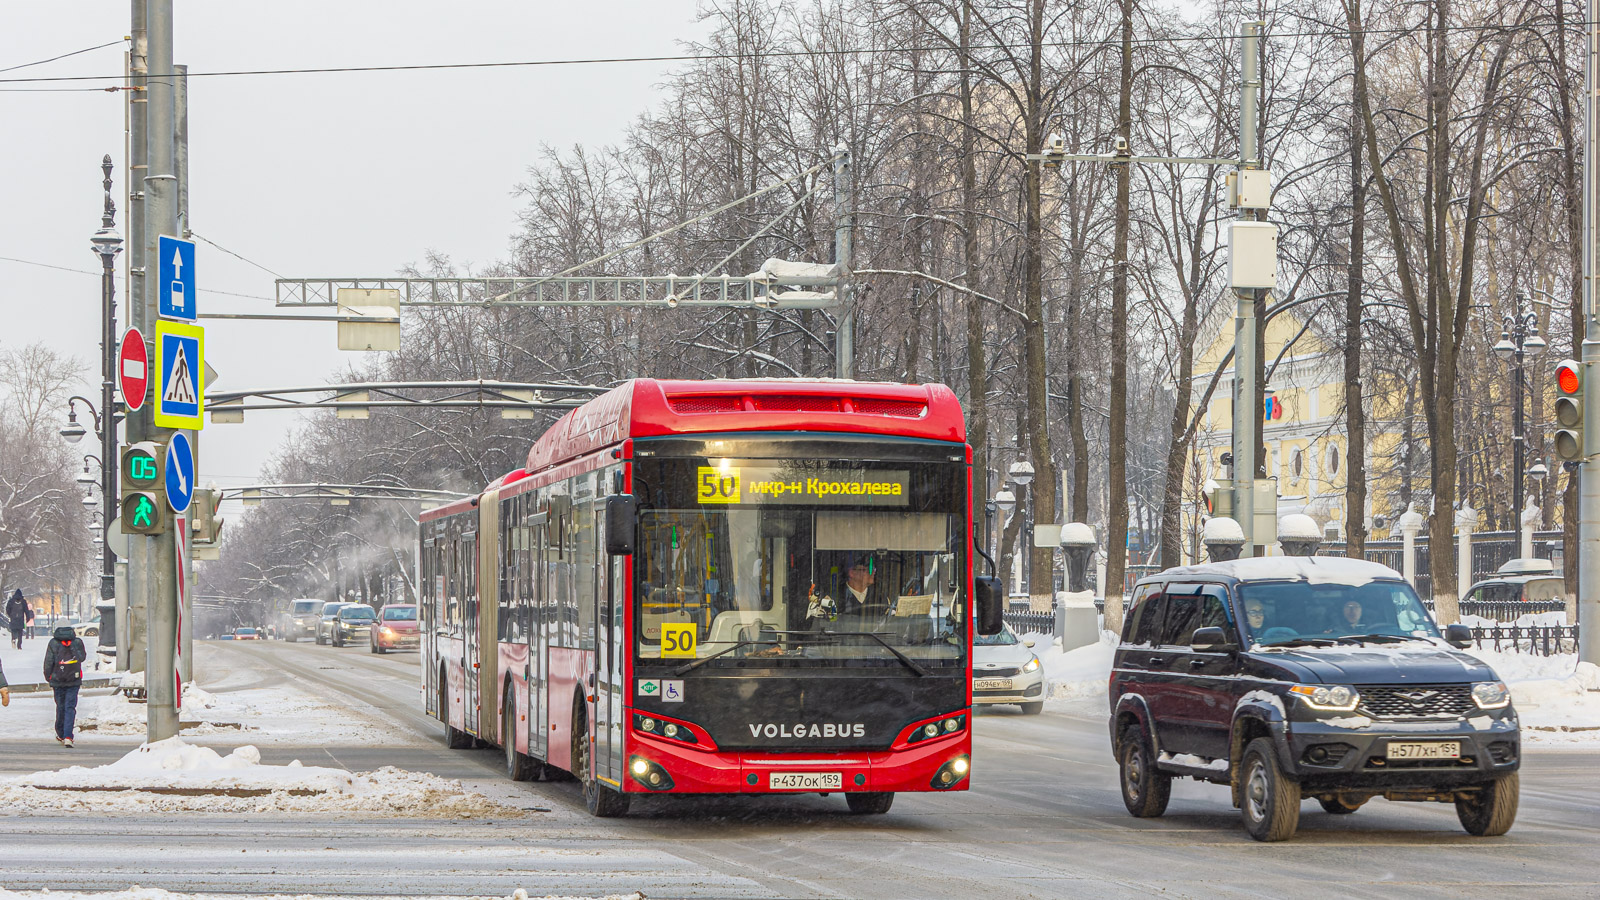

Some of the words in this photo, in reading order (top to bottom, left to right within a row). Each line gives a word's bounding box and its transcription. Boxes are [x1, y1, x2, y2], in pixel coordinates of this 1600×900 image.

[131, 456, 157, 479] 05
[701, 473, 736, 498] 50
[749, 481, 802, 497] мкр-н
[806, 478, 902, 498] Крохалева
[664, 630, 694, 652] 50
[748, 723, 866, 738] VOLGABUS
[1439, 743, 1457, 753] 159
[821, 774, 839, 784] 159
